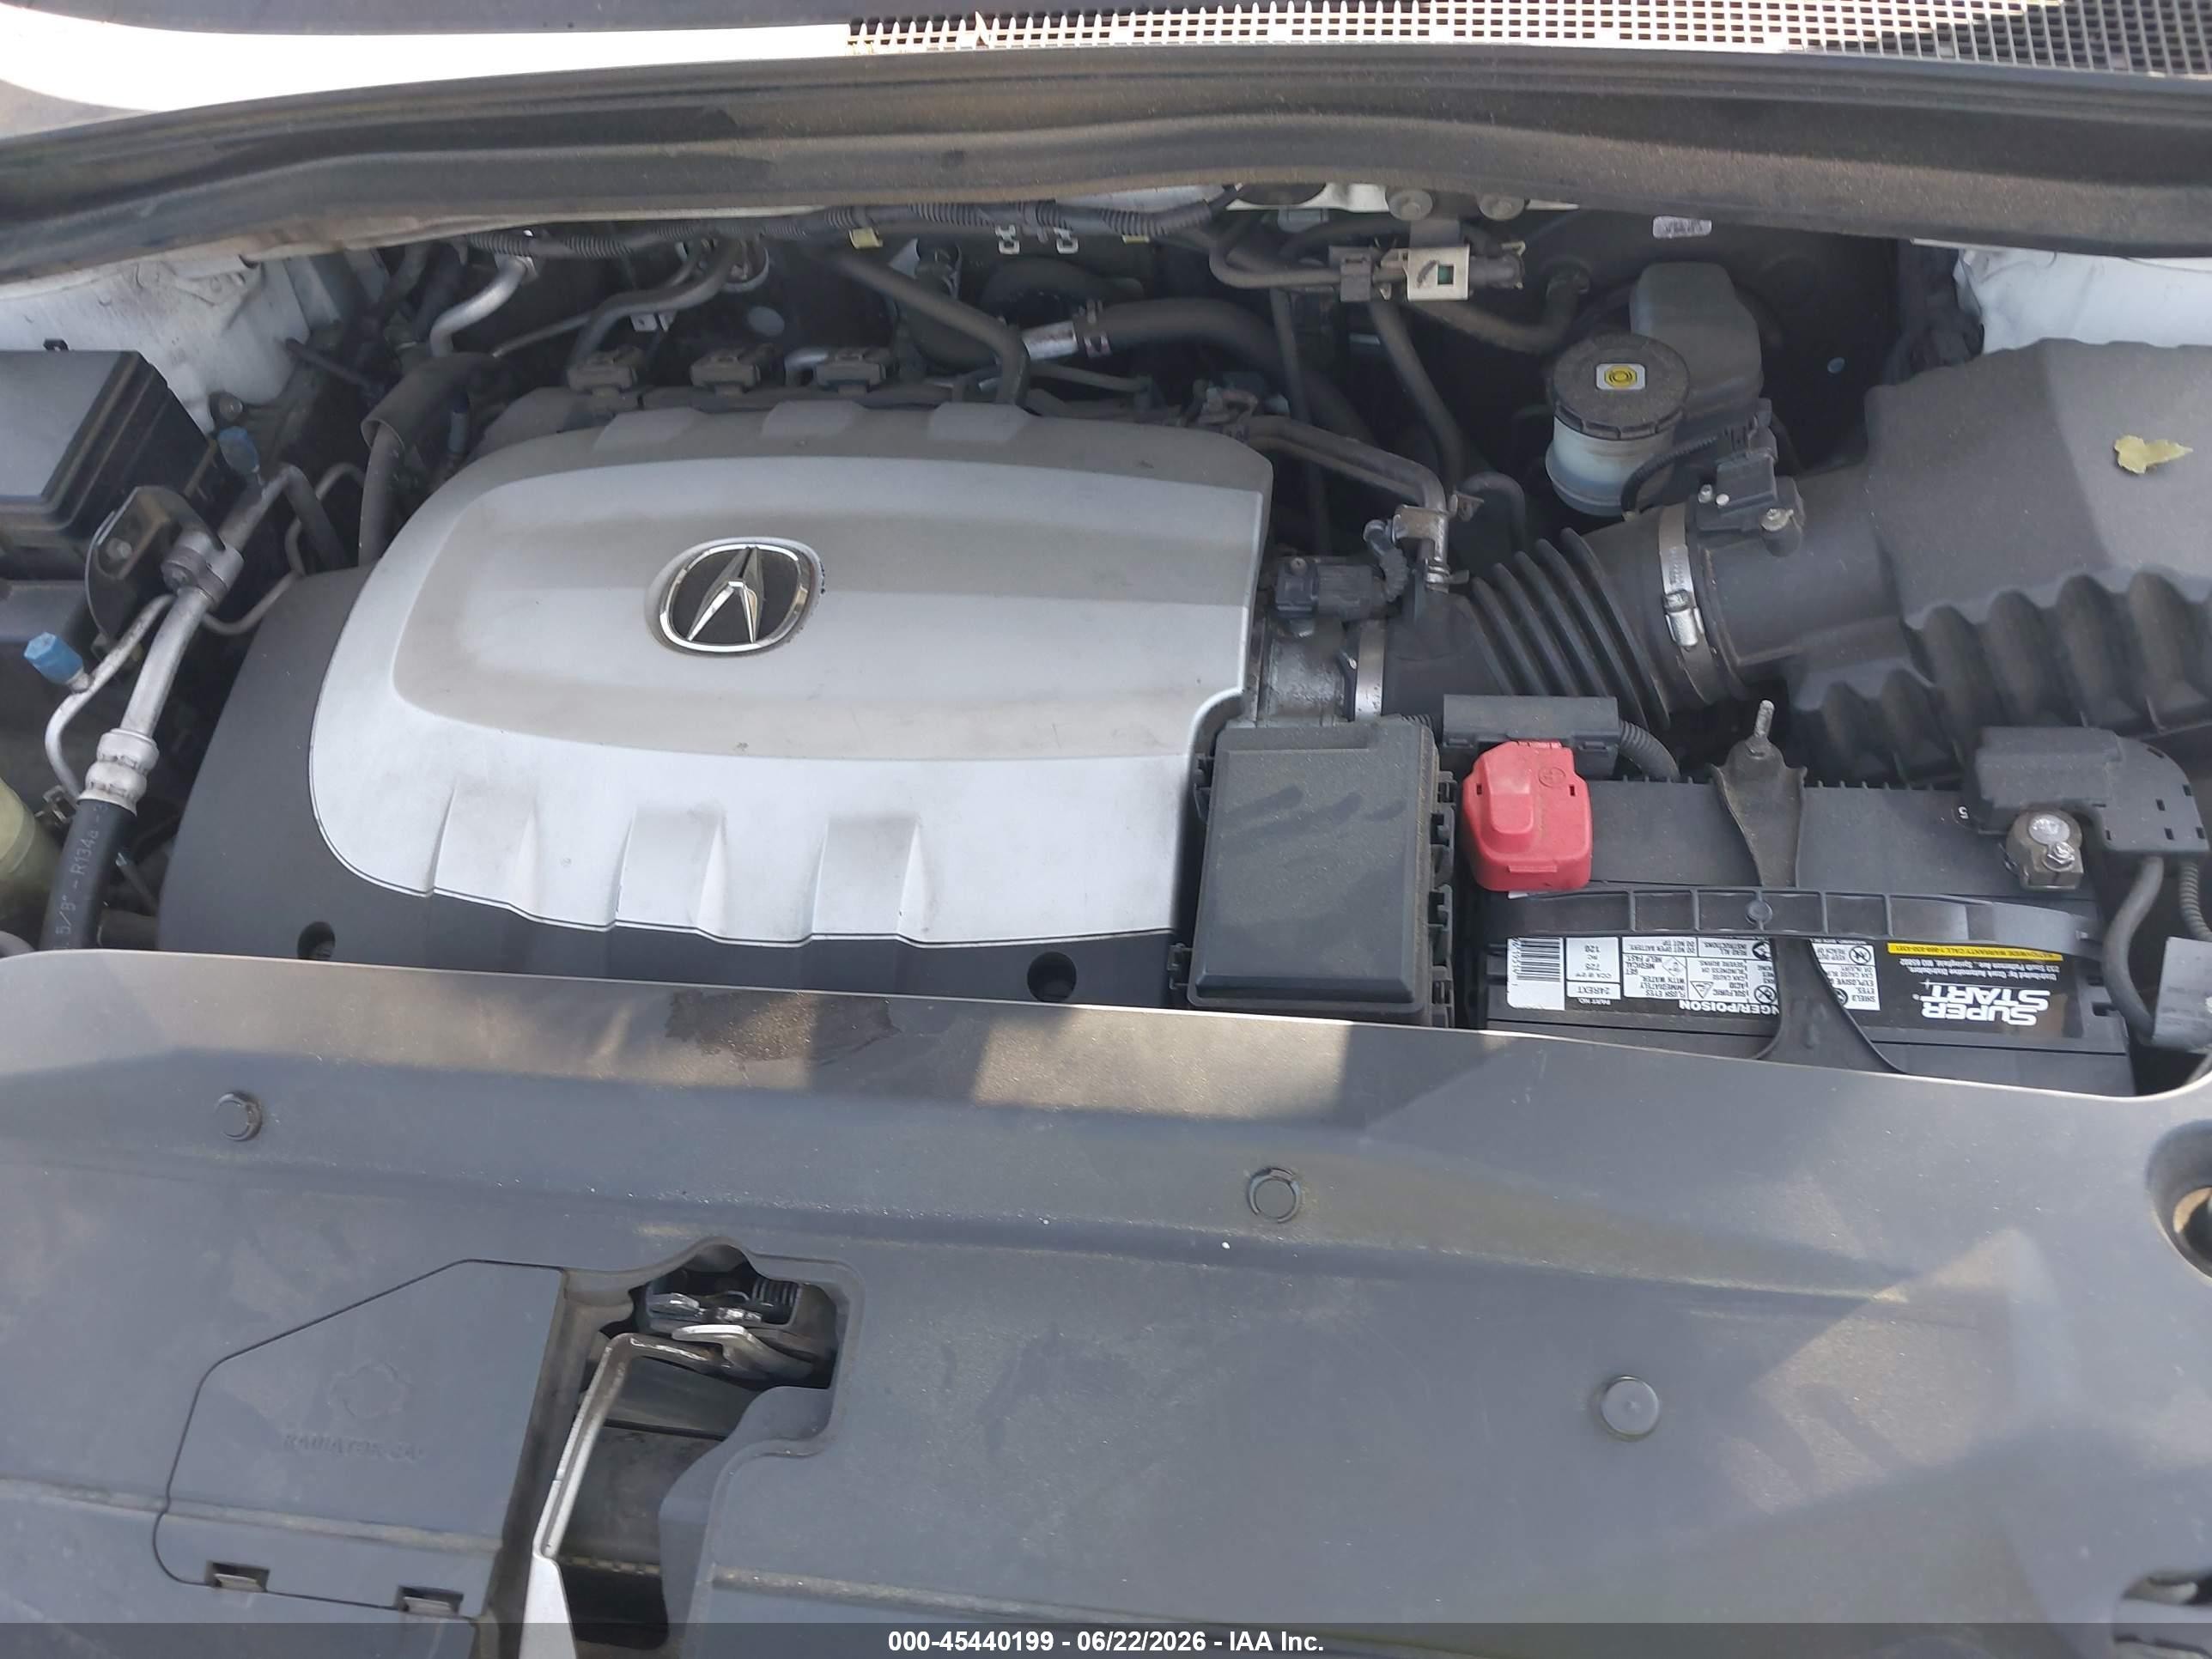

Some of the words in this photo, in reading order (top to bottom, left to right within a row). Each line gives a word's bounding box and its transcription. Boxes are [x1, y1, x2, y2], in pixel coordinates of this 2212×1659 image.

[1958, 805, 1969, 819] 5
[1920, 985, 2051, 1012] START
[1921, 1001, 2038, 1026] SUPER
